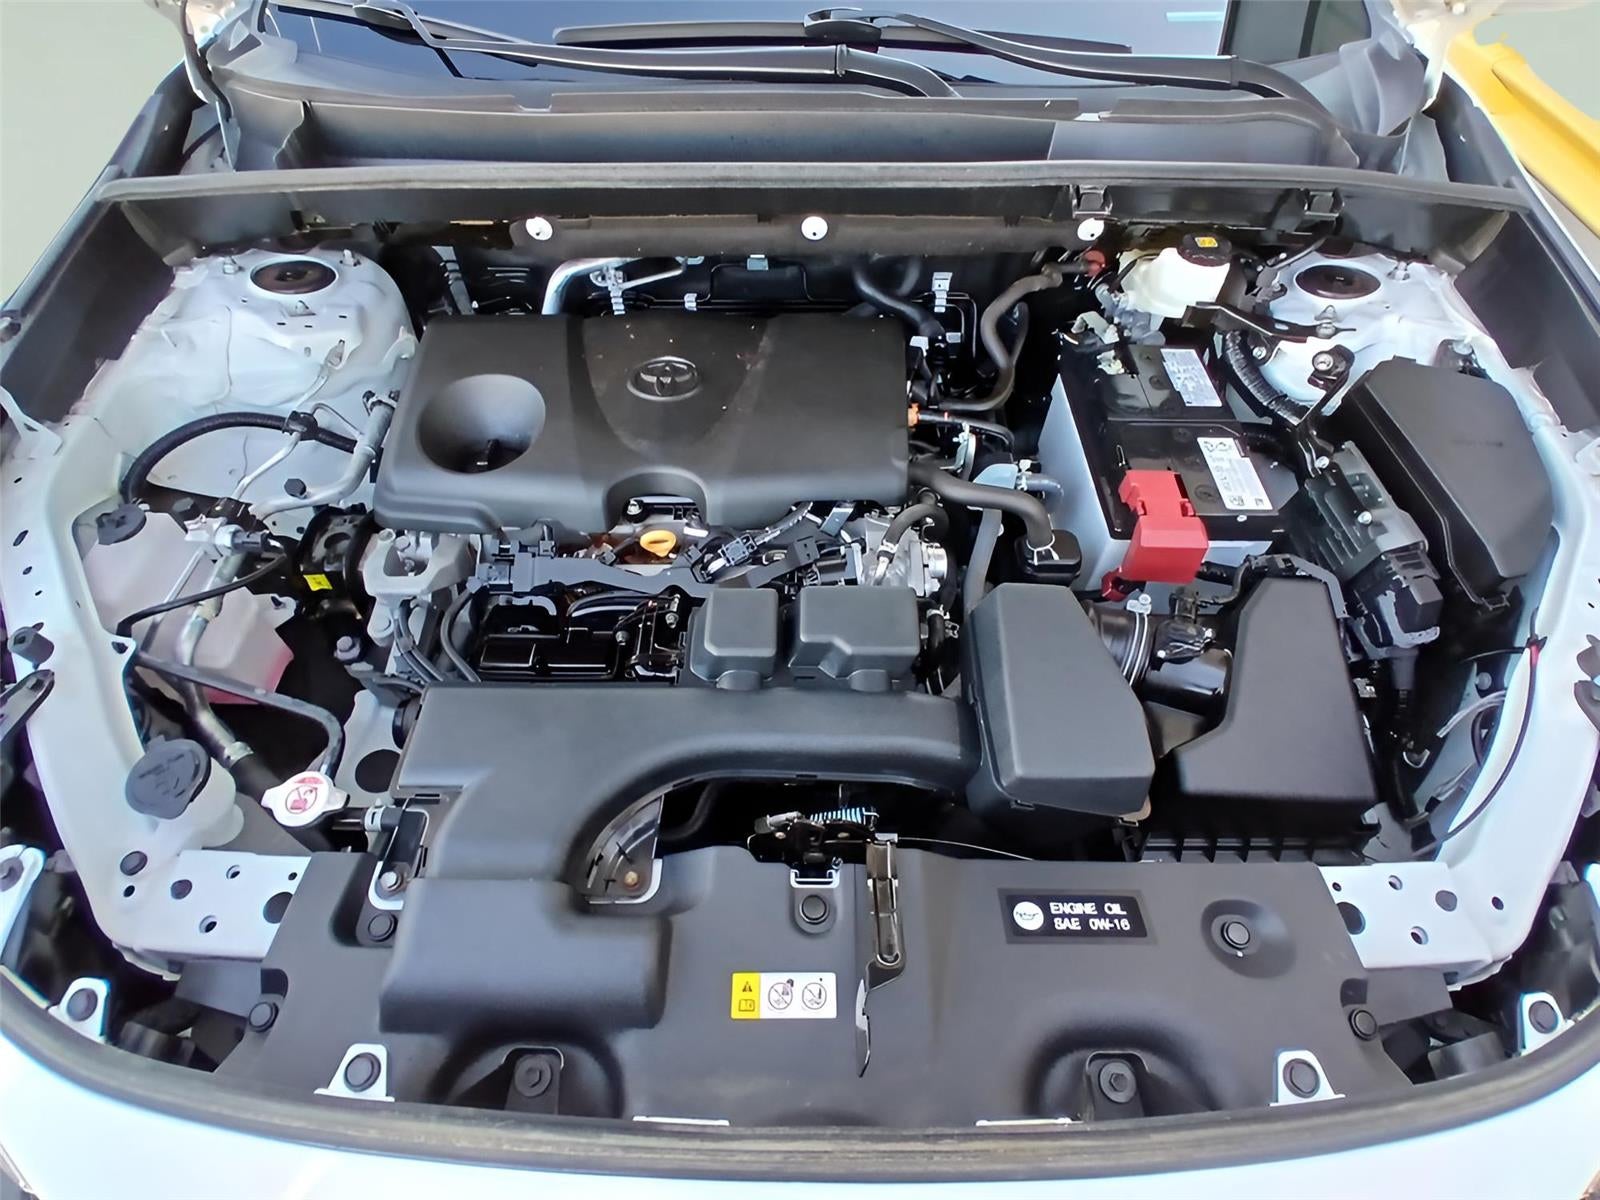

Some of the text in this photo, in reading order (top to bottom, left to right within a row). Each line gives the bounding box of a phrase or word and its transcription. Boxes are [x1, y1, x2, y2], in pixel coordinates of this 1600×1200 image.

[1049, 902, 1127, 915] ENGINE OIL
[1053, 917, 1131, 931] SAE 0W-16
